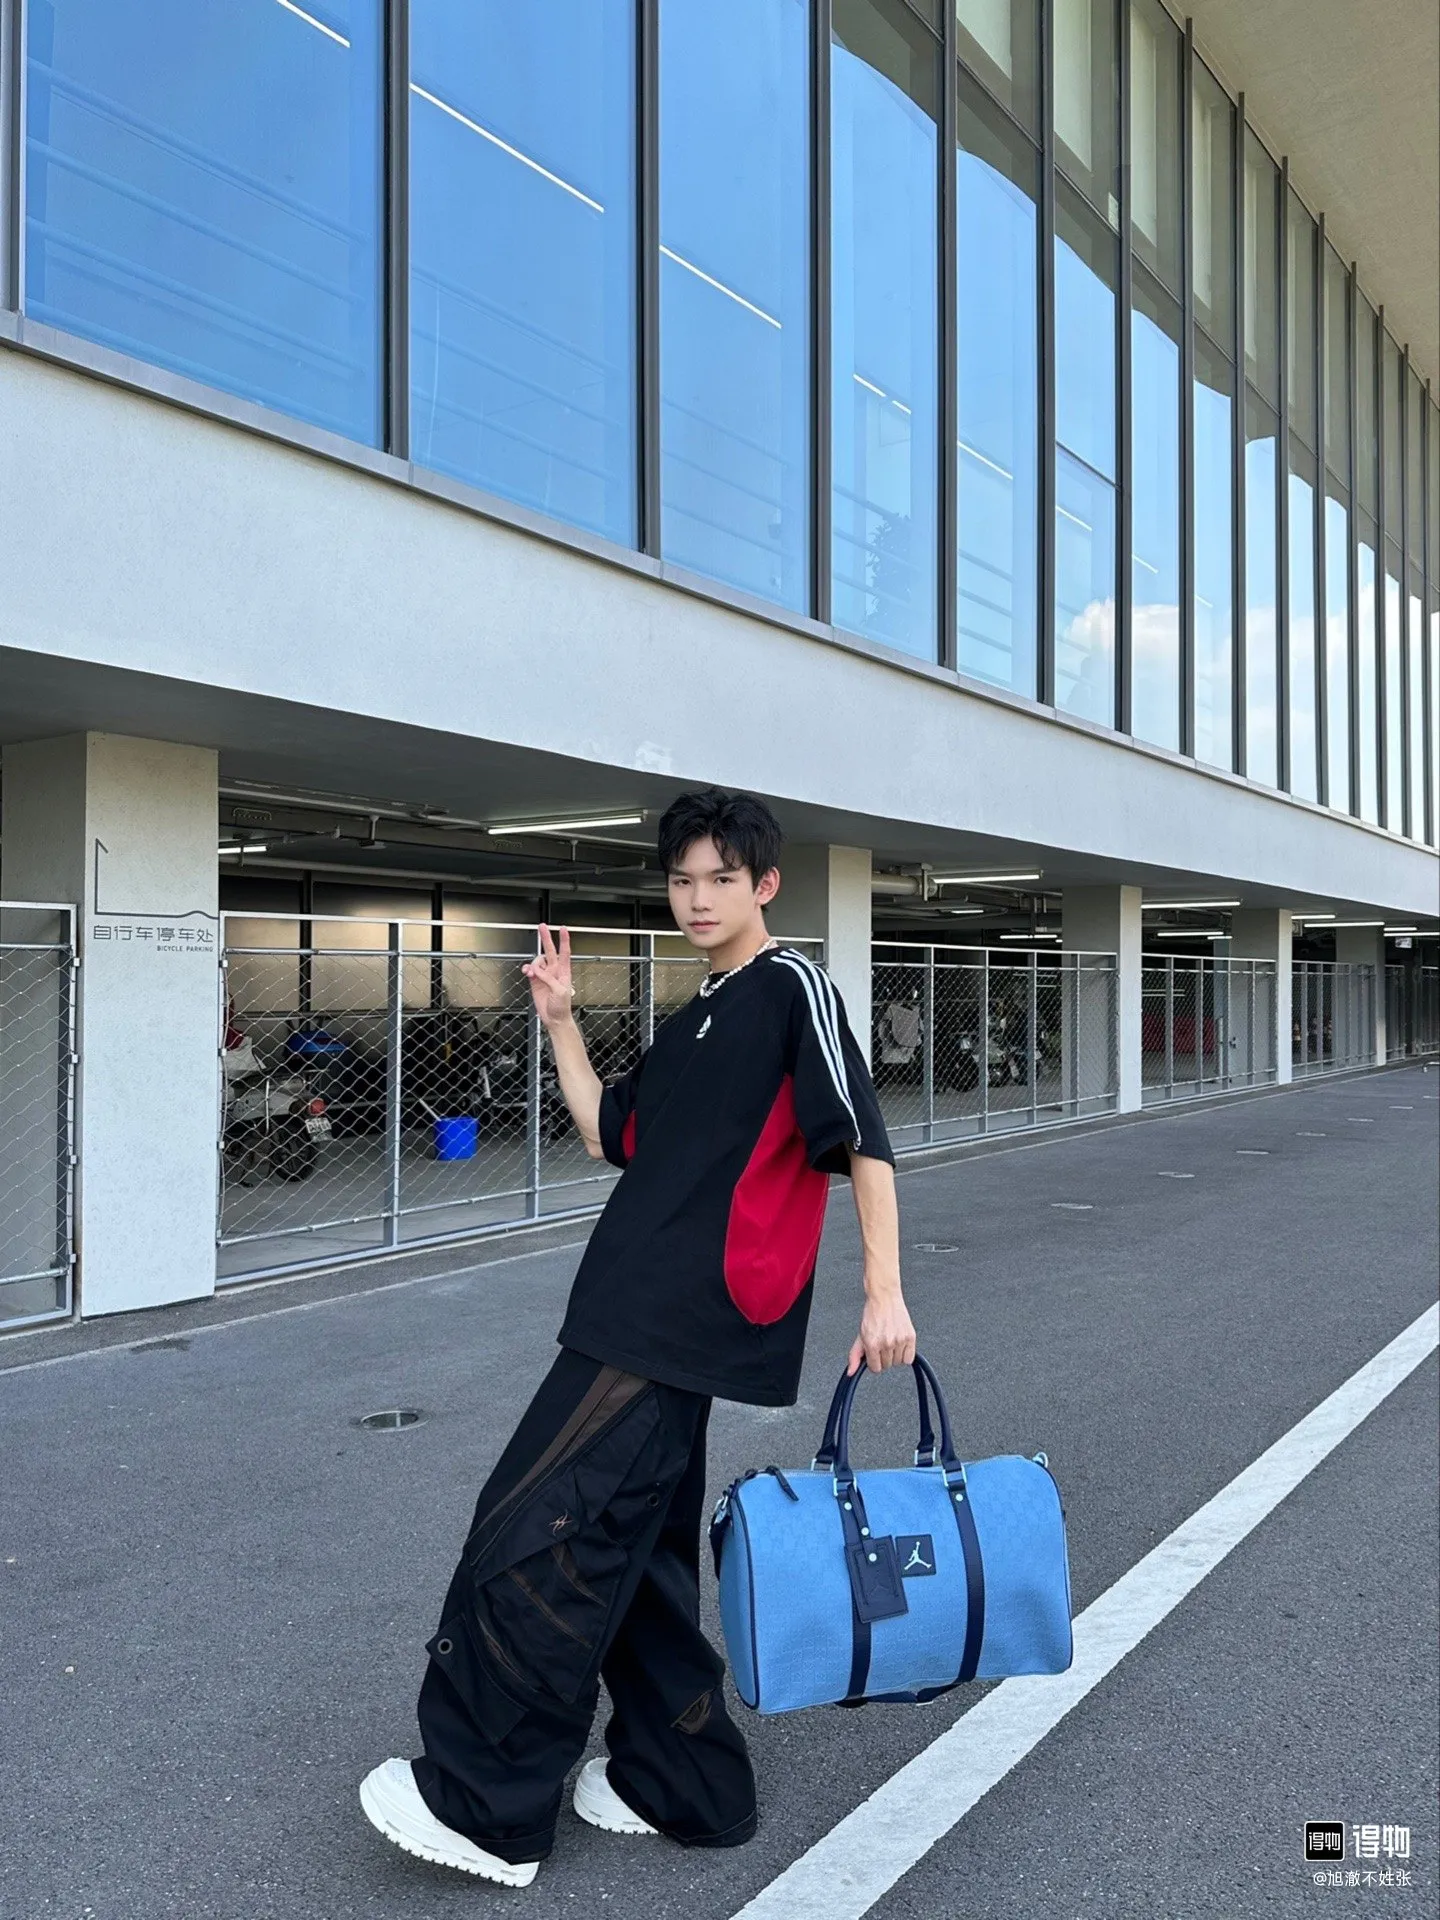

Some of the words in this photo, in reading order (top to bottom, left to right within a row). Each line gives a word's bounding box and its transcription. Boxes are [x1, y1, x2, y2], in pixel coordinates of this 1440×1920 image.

[93, 925, 213, 942] 自行车停车处
